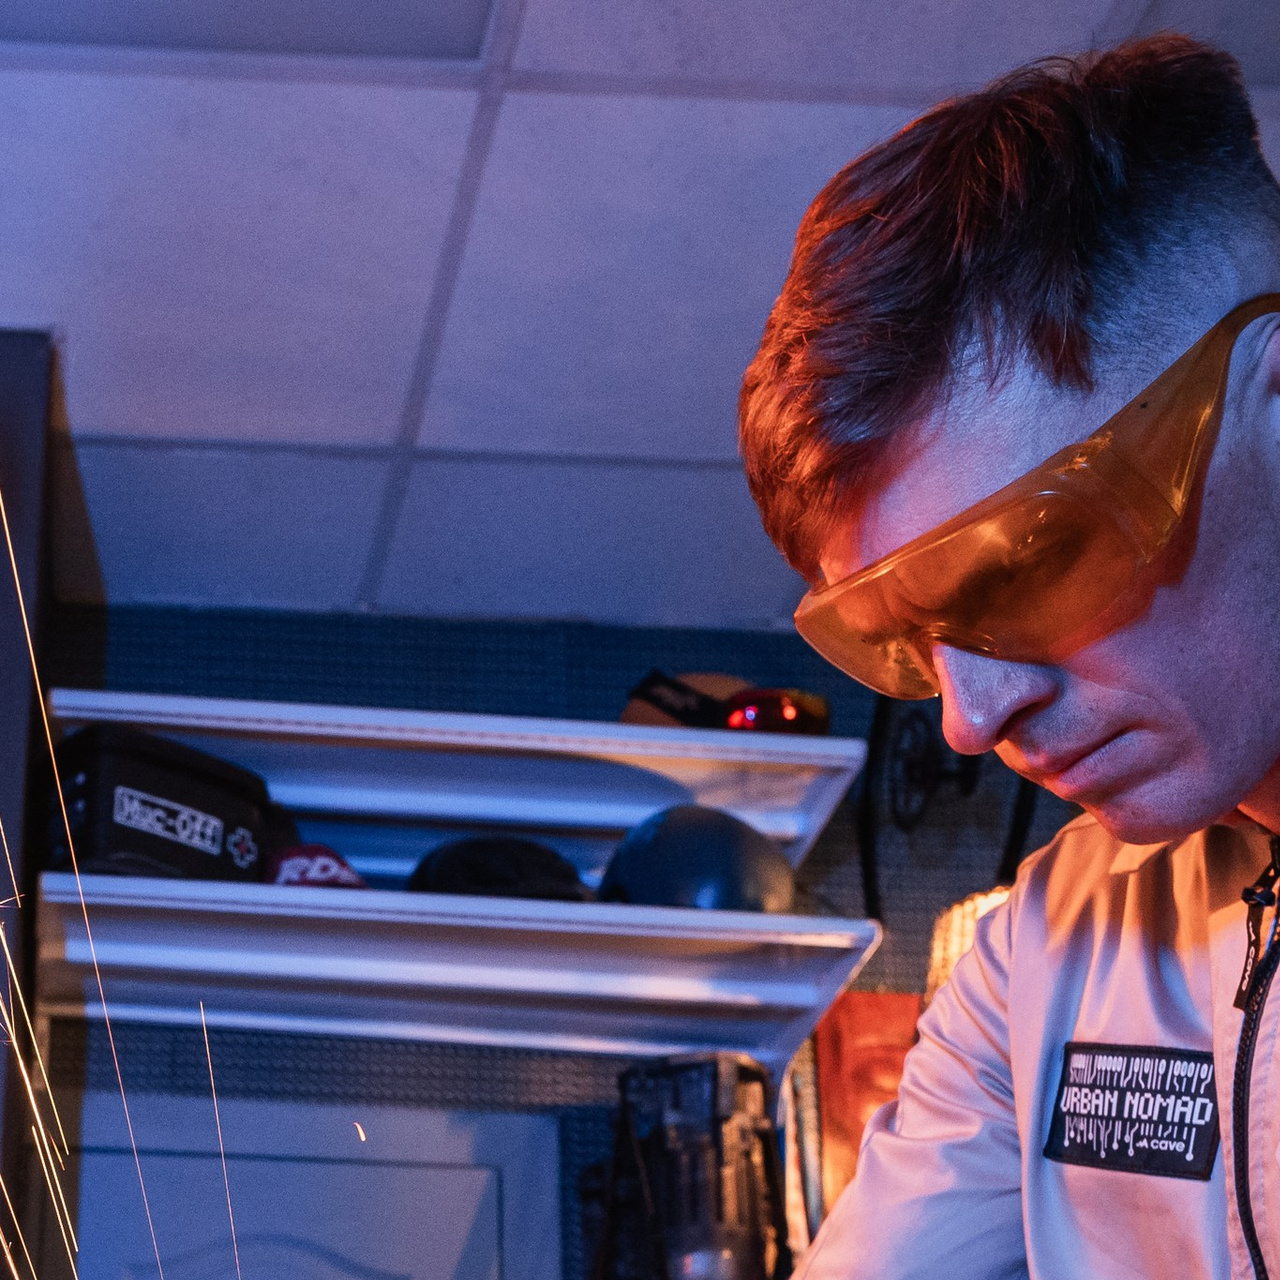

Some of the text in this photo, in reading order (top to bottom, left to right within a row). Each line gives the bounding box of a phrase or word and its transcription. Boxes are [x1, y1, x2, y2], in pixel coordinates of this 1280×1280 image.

[1060, 1086, 1214, 1126] URBAN NOMAD
[1150, 1139, 1186, 1153] cave
